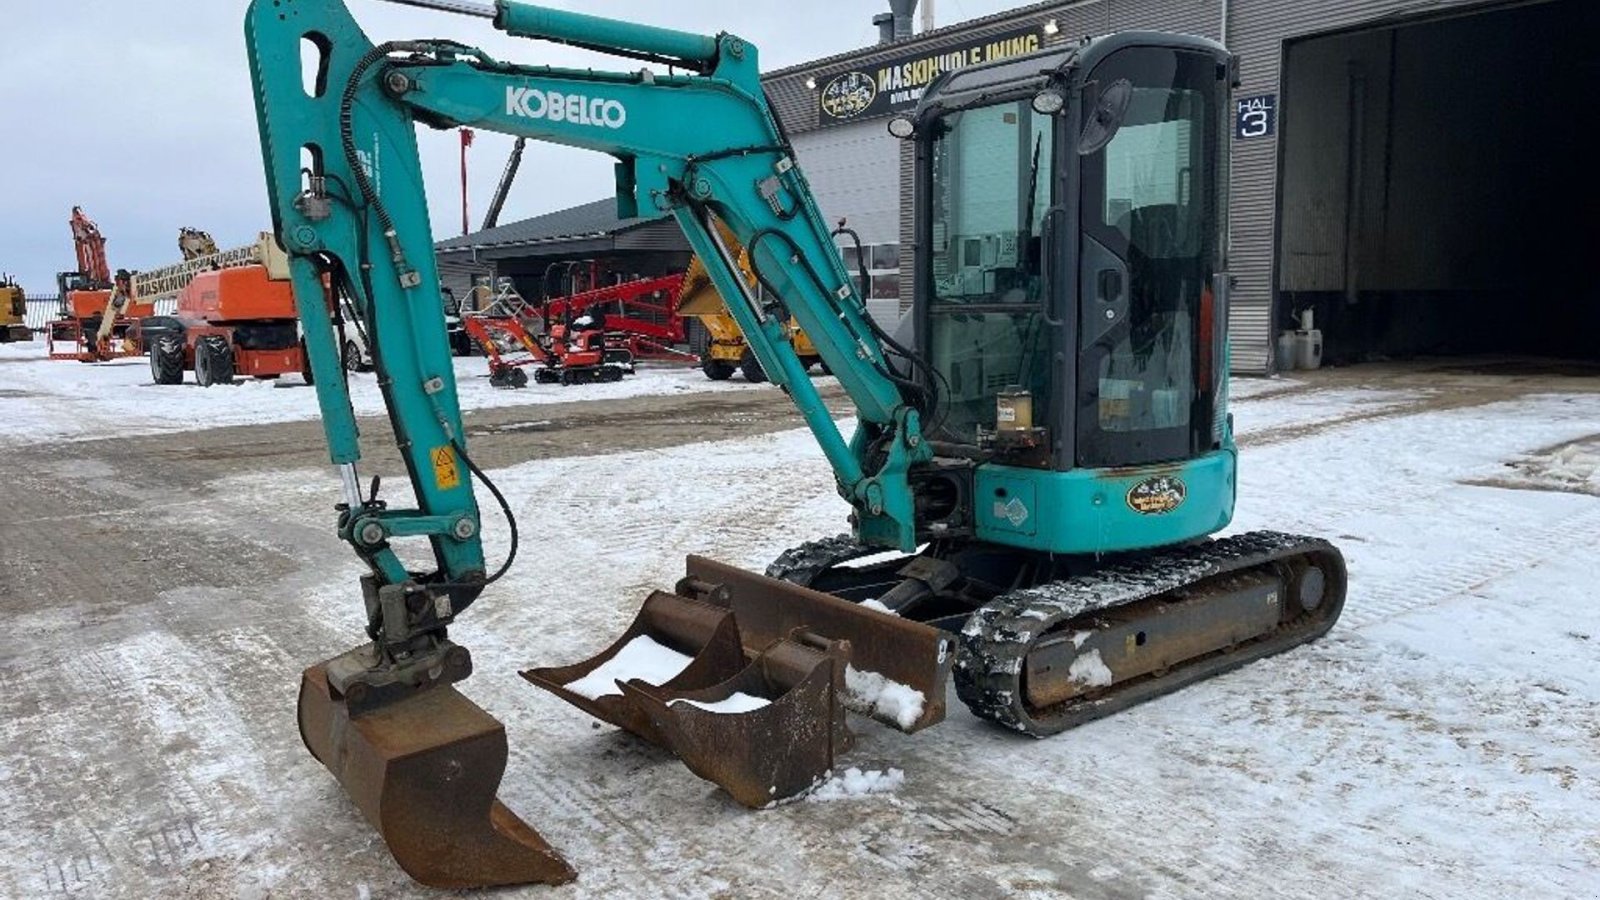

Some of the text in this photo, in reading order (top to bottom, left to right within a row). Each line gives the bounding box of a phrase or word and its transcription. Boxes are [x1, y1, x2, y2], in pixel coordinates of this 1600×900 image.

[506, 85, 626, 129] KOBELCO
[1239, 97, 1272, 113] HAL
[1242, 110, 1267, 137] 3
